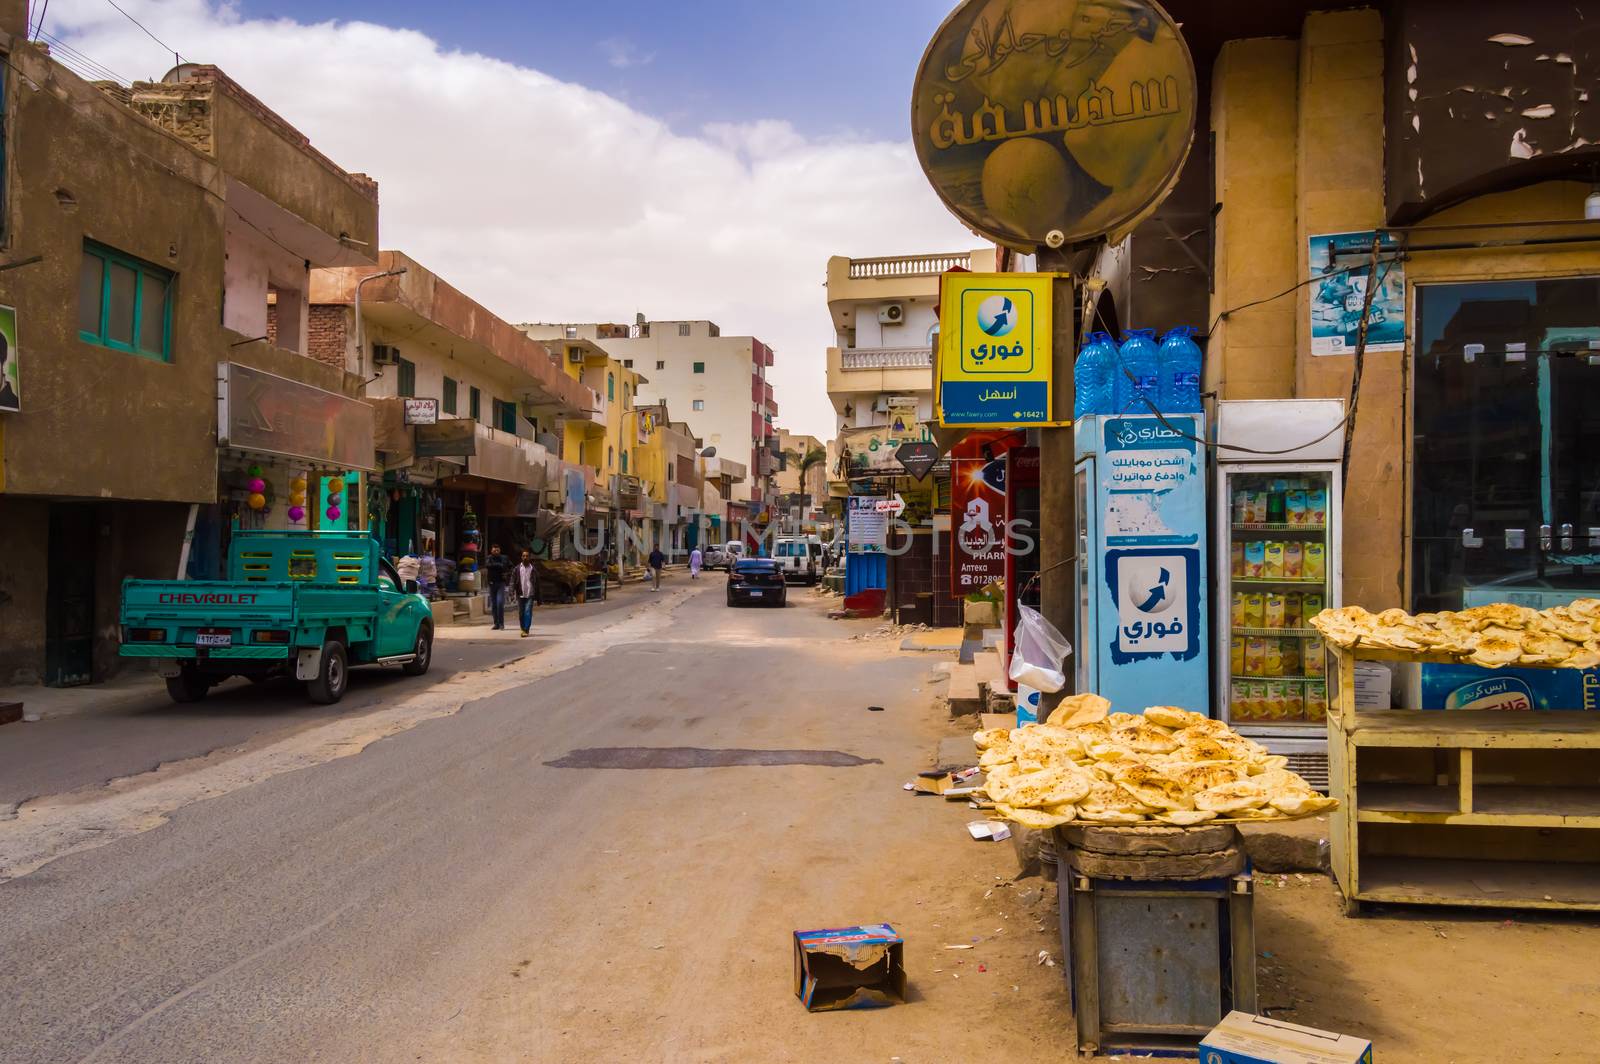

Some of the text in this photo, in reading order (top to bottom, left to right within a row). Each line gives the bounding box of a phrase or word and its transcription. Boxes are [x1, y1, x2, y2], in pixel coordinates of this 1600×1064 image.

[930, 75, 1180, 149] سمسمة
[970, 340, 1024, 365] فوري
[1022, 410, 1044, 419] 16421
[159, 593, 258, 604] CHEVROLET
[1123, 617, 1183, 644] فوري
